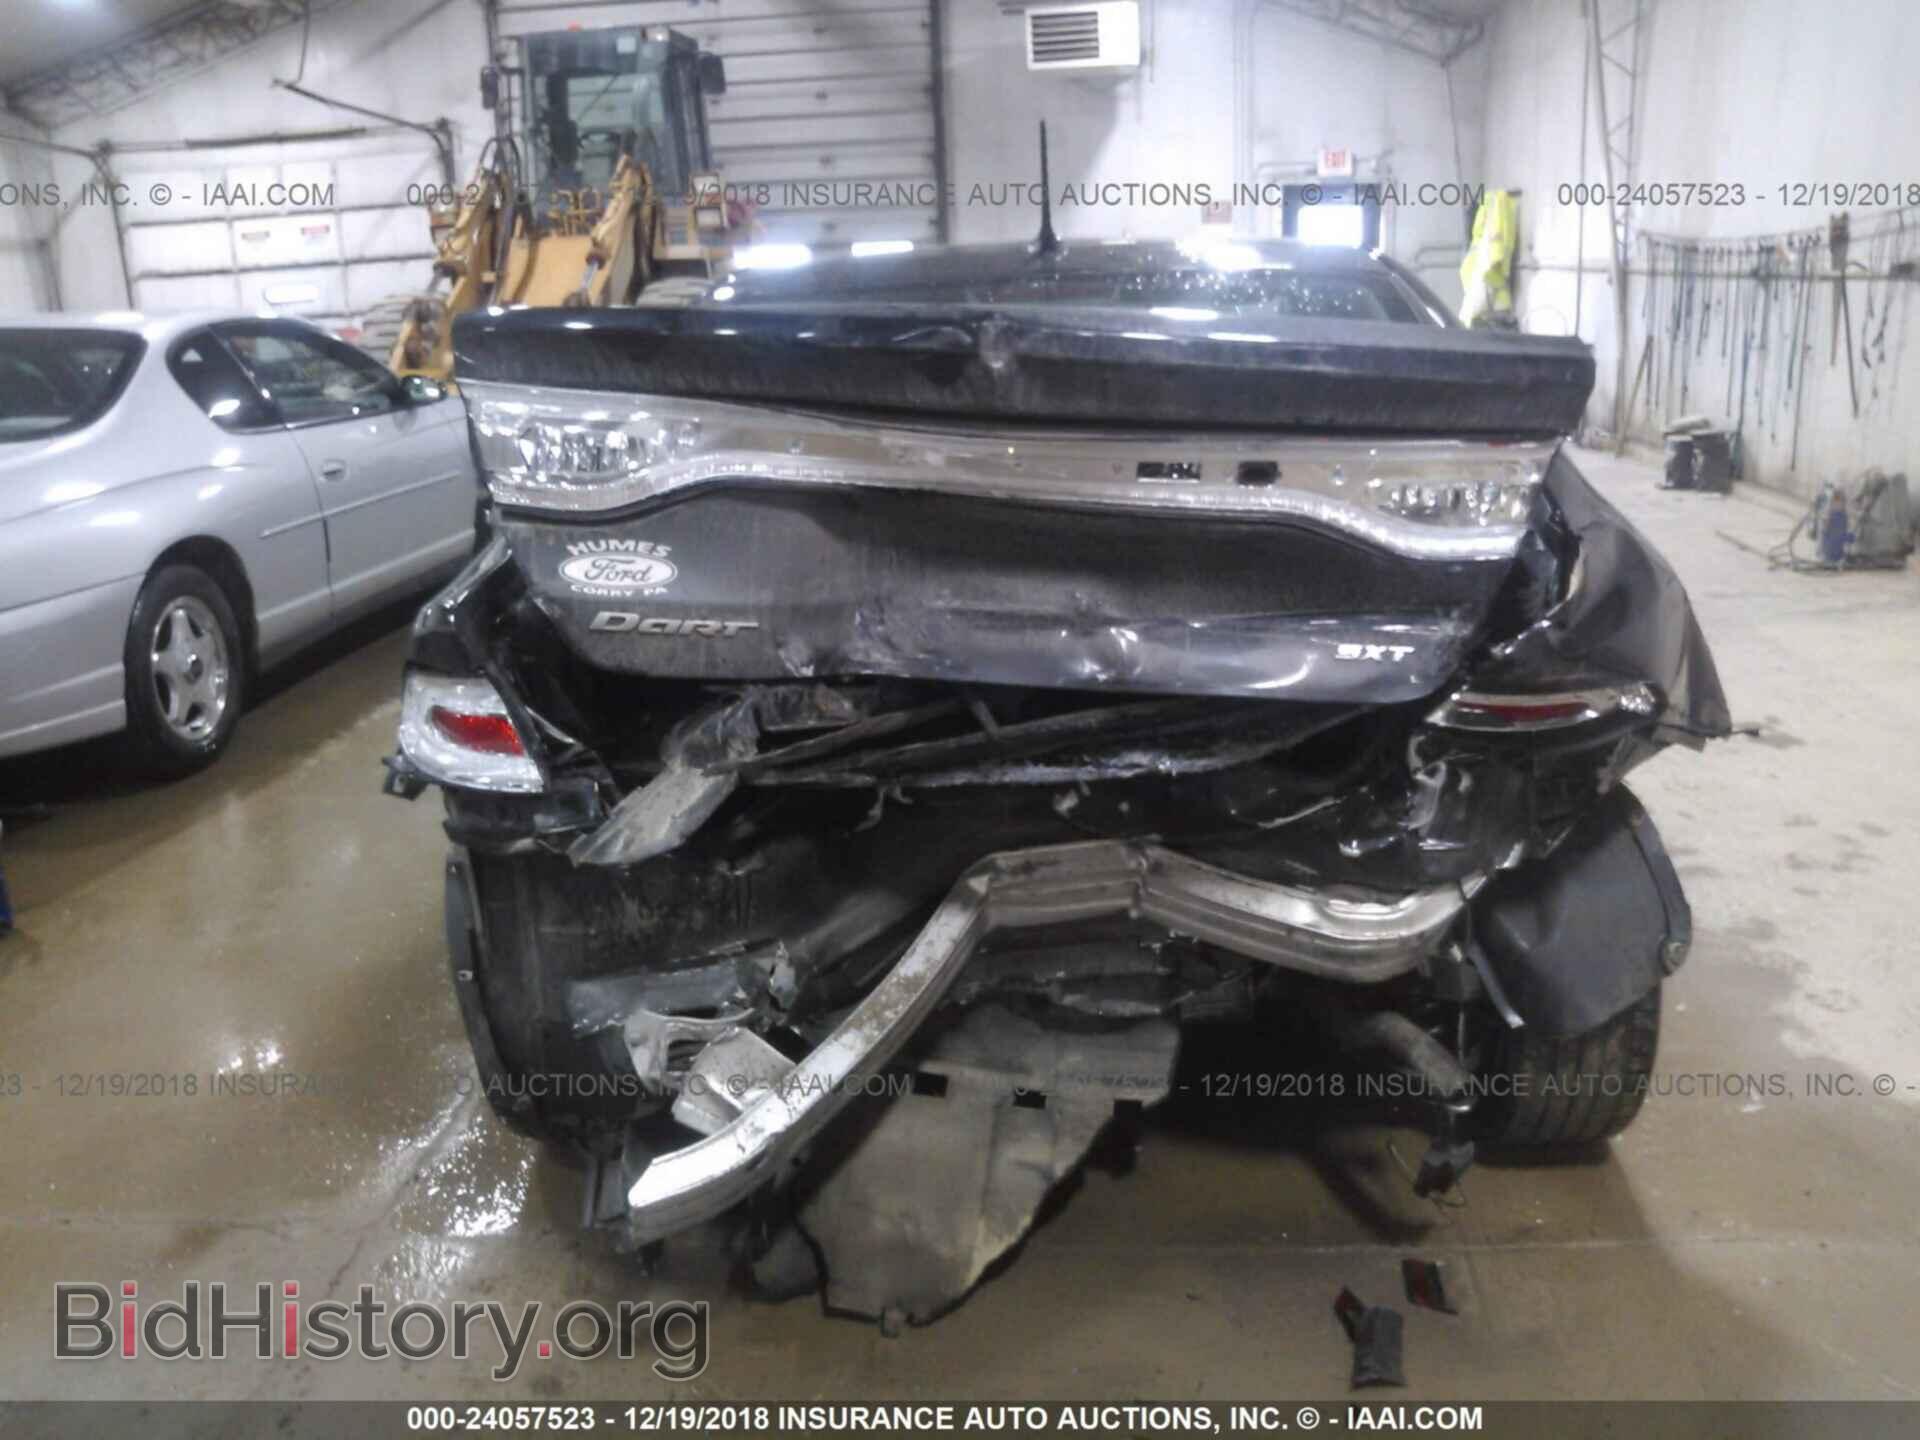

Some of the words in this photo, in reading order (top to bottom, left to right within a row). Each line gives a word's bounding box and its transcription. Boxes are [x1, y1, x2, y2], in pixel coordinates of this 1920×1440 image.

[566, 539, 672, 557] HUMES
[584, 558, 653, 583] Ford
[1335, 643, 1415, 662] SXT
